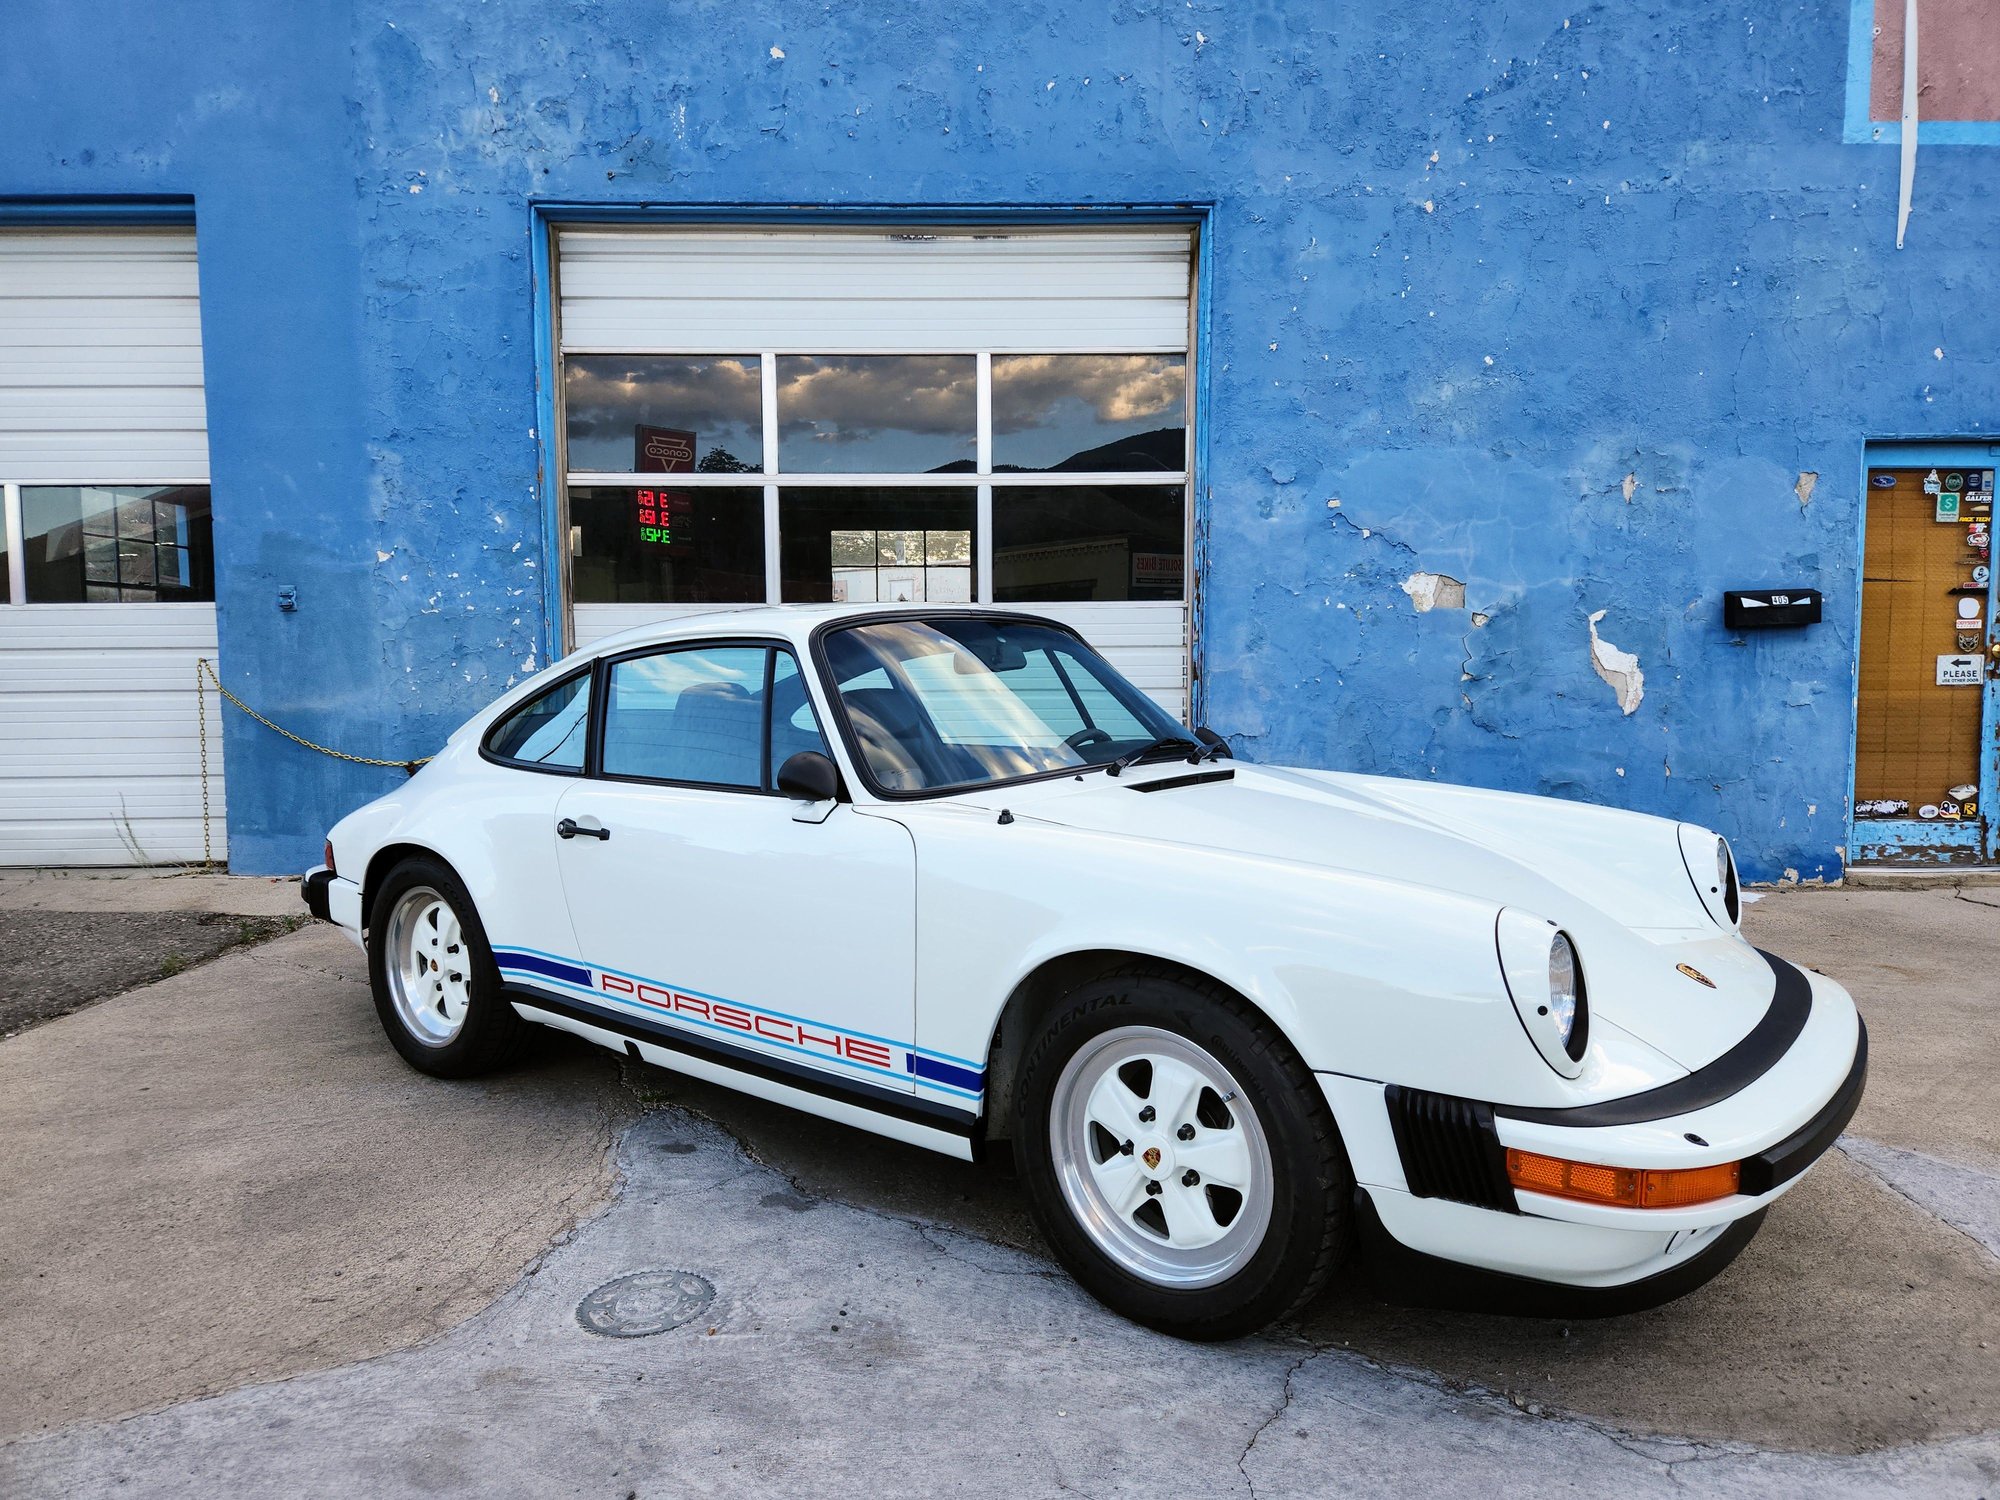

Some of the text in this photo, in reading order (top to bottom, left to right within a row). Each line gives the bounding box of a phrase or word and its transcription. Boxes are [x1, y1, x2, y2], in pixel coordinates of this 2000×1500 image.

[1943, 670, 1978, 678] PLEASE
[601, 973, 891, 1068] PORSCHE
[1017, 993, 1133, 1119] CONTINENTAL
